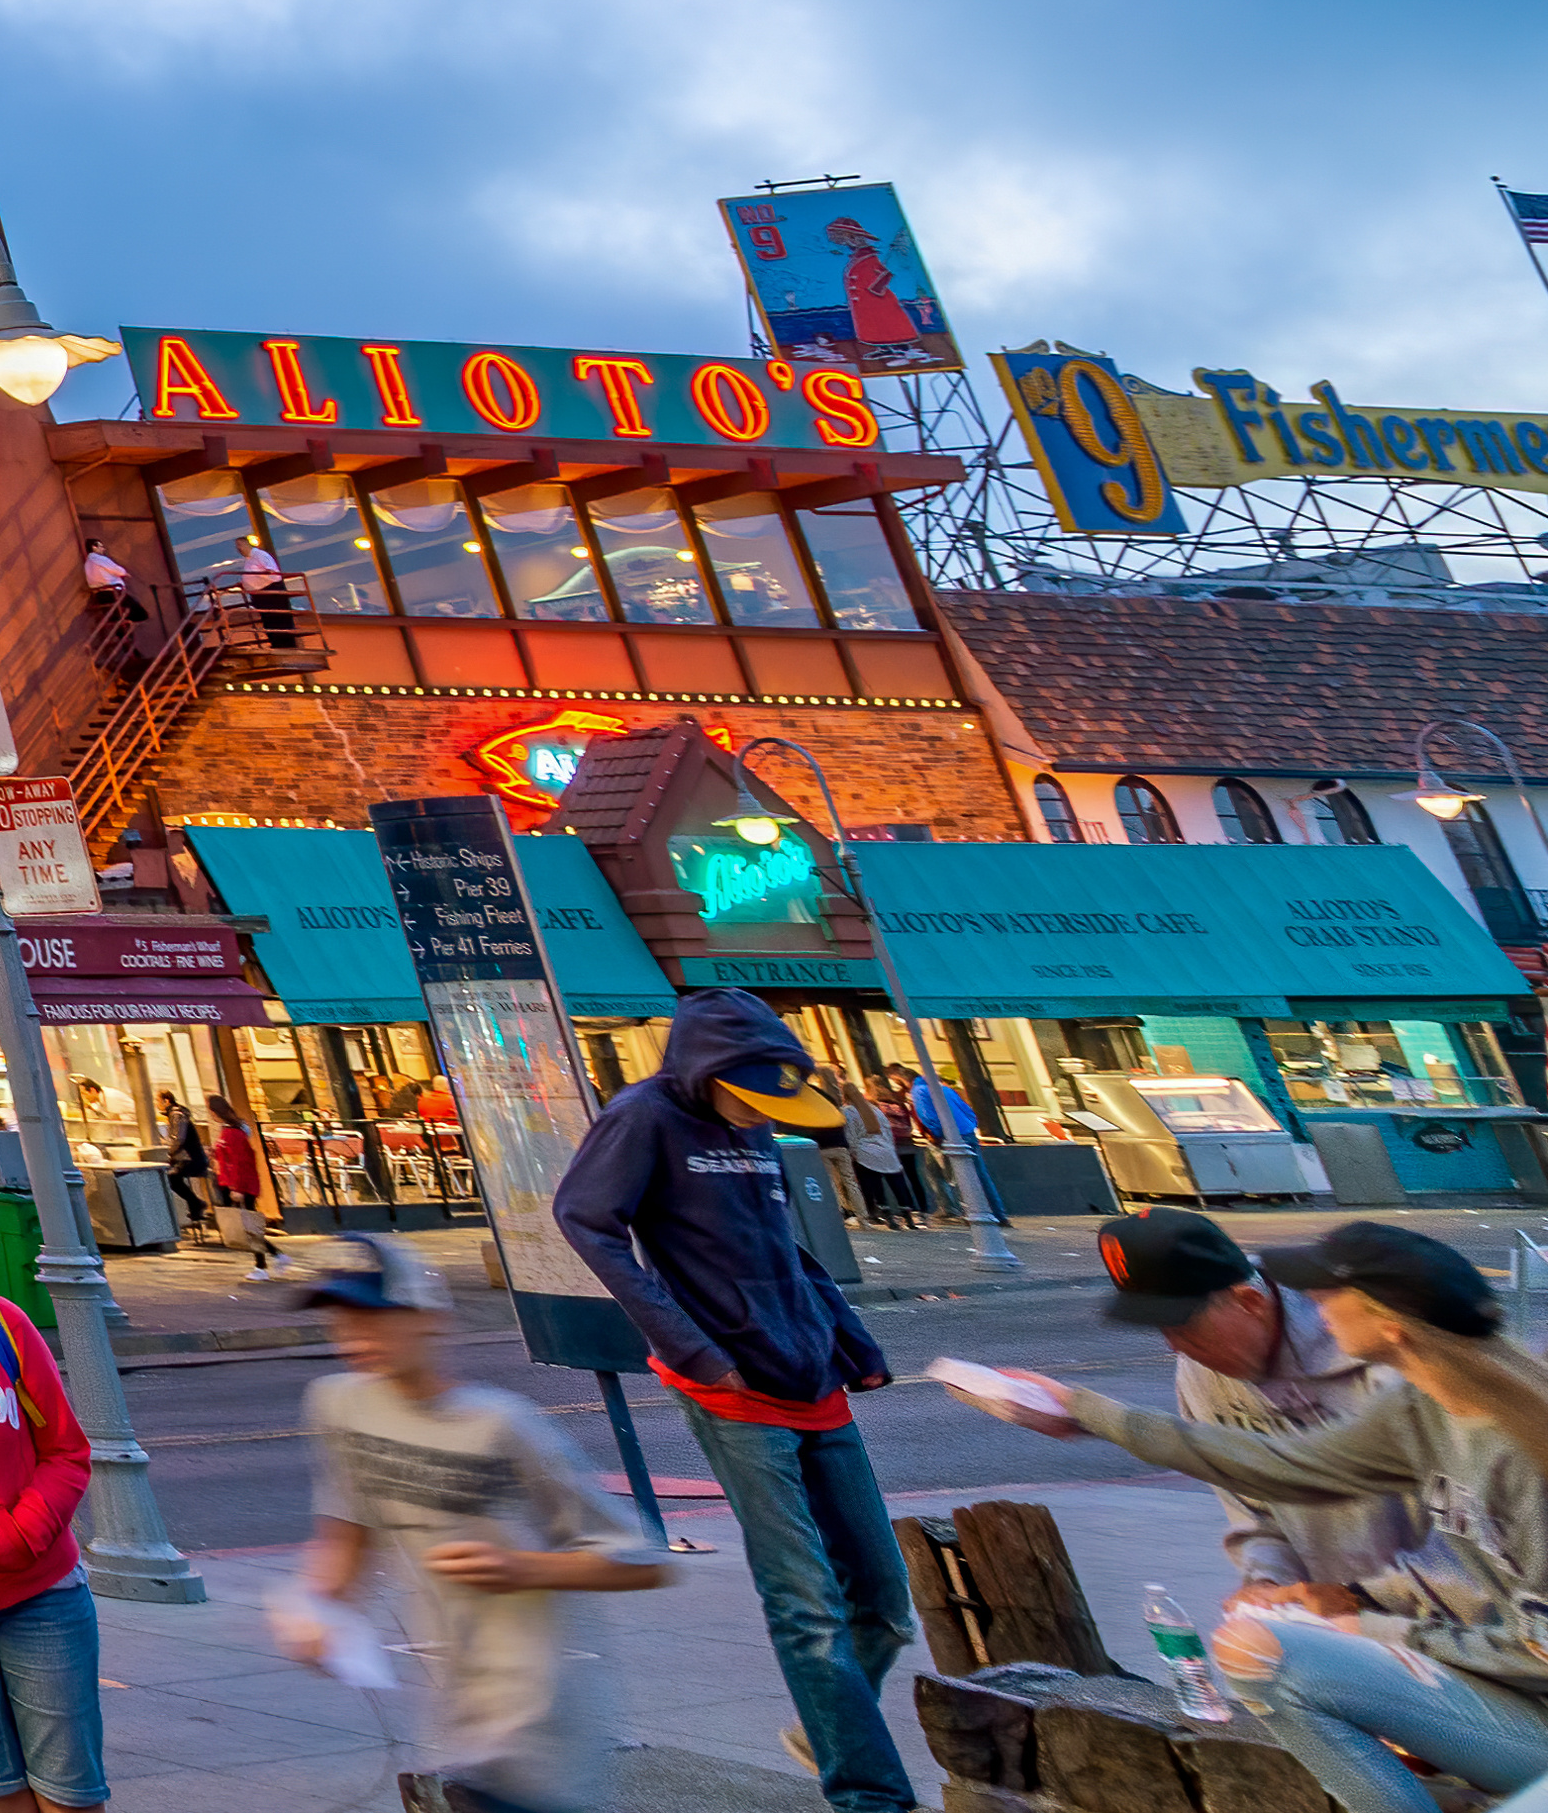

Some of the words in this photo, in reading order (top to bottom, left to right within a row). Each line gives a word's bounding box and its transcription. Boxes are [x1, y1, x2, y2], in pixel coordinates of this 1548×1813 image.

[748, 226, 788, 260] 9
[152, 335, 881, 448] ALIOTO'S
[1061, 360, 1163, 524] 9
[14, 805, 75, 828] STOPPING
[18, 839, 56, 860] ANY
[459, 848, 504, 869] Ships
[19, 864, 69, 885] TIME
[454, 878, 484, 897] Pier
[485, 877, 512, 897] 39
[486, 904, 524, 926] Fleet
[1136, 913, 1209, 935] CAFE
[479, 937, 532, 957] Ferries
[714, 961, 853, 985] ENTRANCE
[43, 1004, 91, 1020] FAMOUS
[91, 1005, 114, 1020] FOR
[114, 1005, 137, 1020] OUR
[137, 1004, 178, 1020] FAMILY
